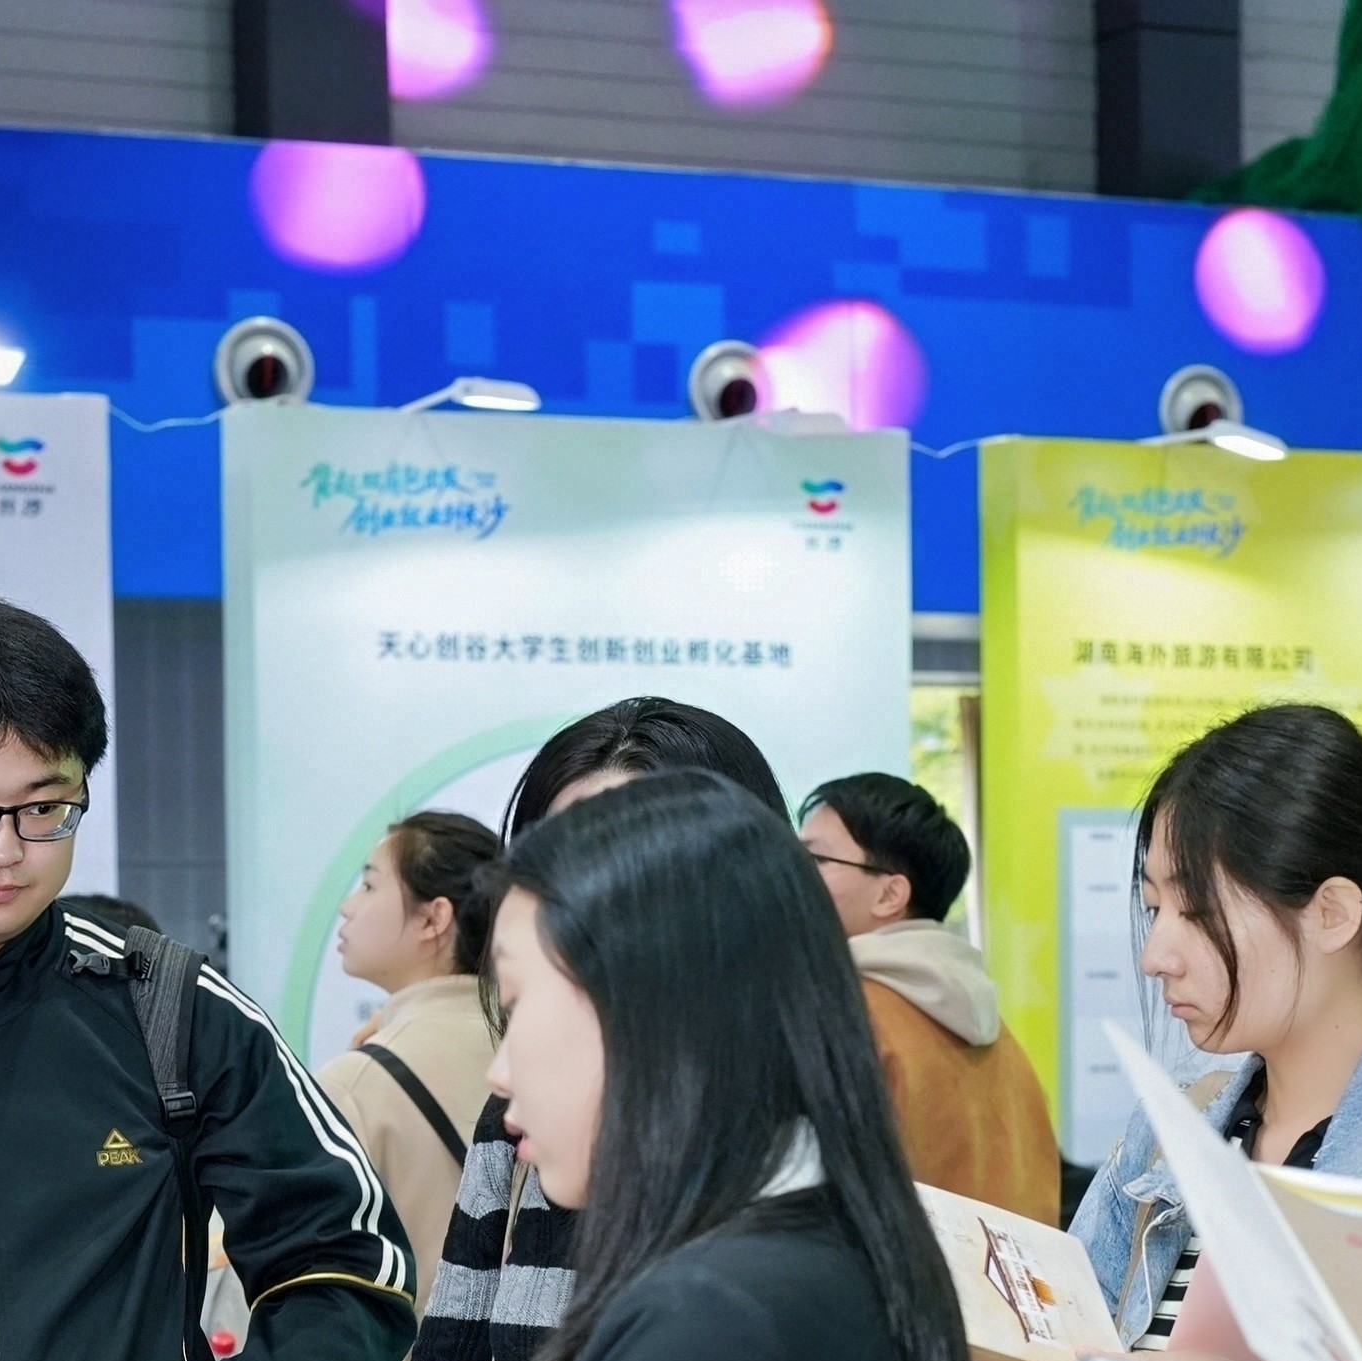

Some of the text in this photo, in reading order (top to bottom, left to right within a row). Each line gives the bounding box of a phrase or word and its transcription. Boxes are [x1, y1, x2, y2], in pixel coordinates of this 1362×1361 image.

[378, 631, 793, 668] 天心创谷大学生创新创业孵化基地
[1074, 640, 1313, 673] 湖南海外旅游有限公司
[96, 1148, 143, 1166] PEAK
